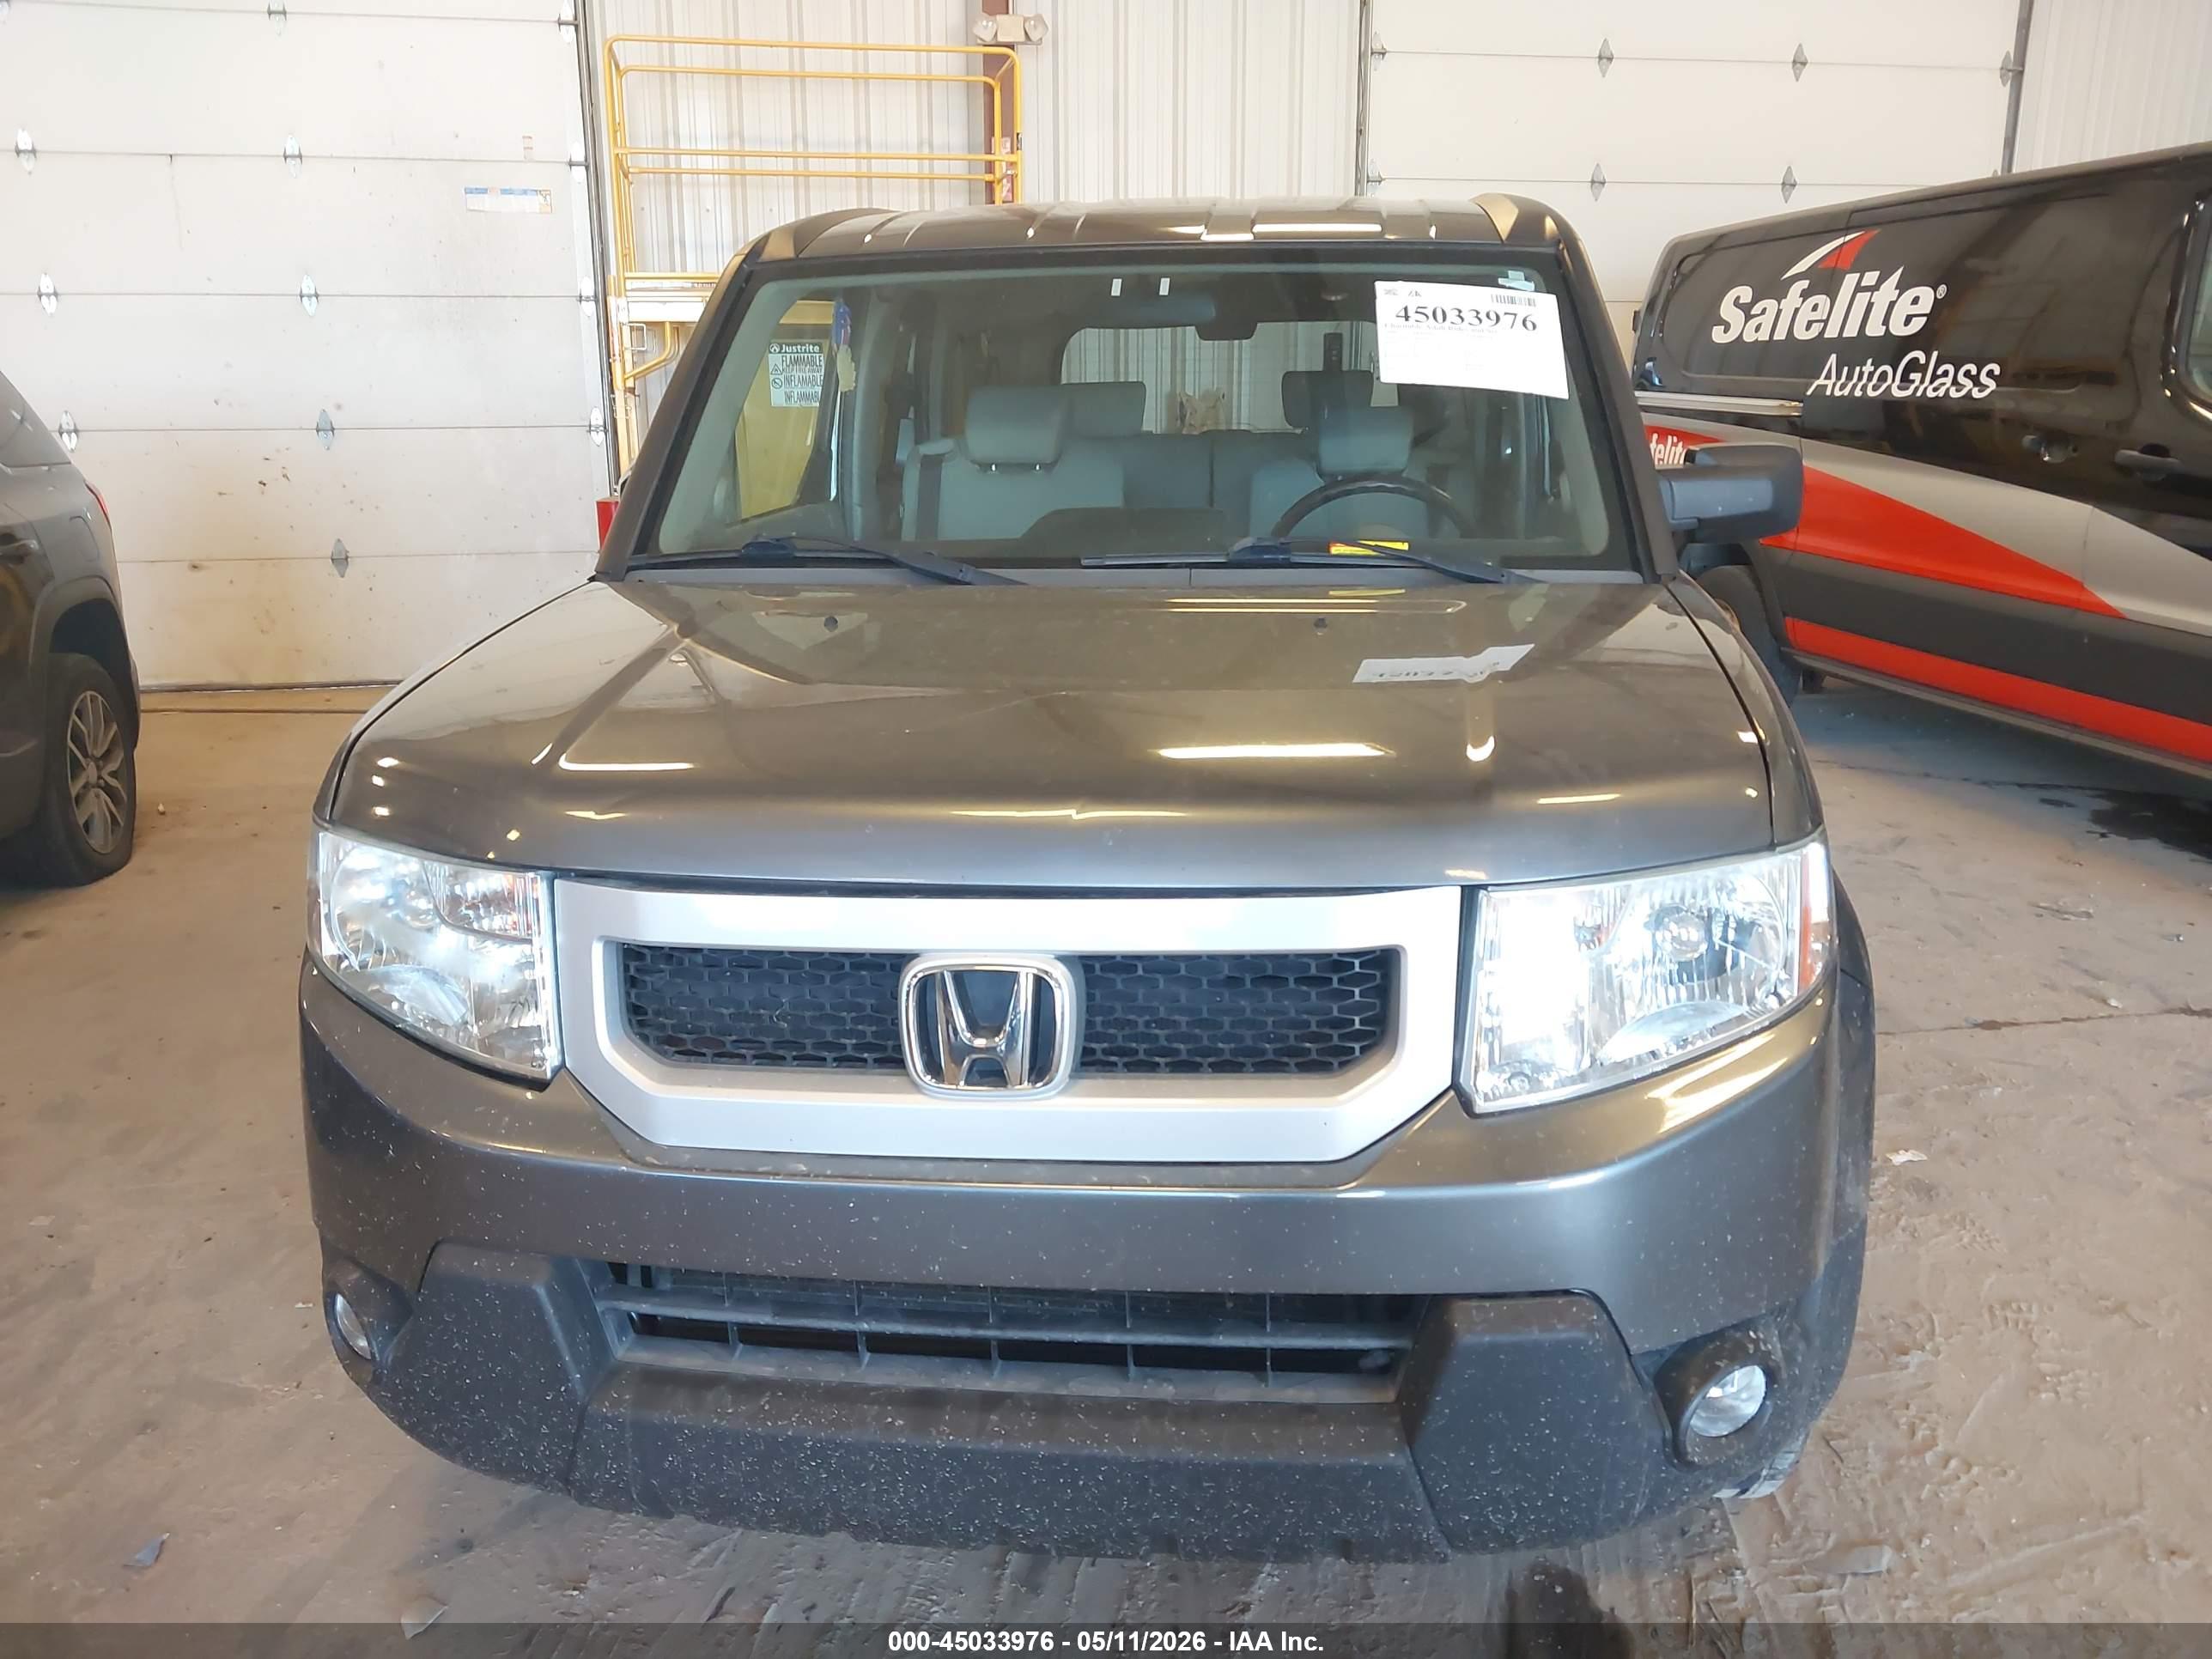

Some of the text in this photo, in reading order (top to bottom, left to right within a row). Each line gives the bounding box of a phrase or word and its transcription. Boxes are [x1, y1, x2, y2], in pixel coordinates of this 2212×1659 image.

[1395, 305, 1538, 331] 45033976
[781, 343, 820, 353] Justrite
[781, 355, 823, 368] FLAMMABLE
[783, 374, 823, 387] INFLAMABLE
[1806, 349, 2001, 399] AutoGlass
